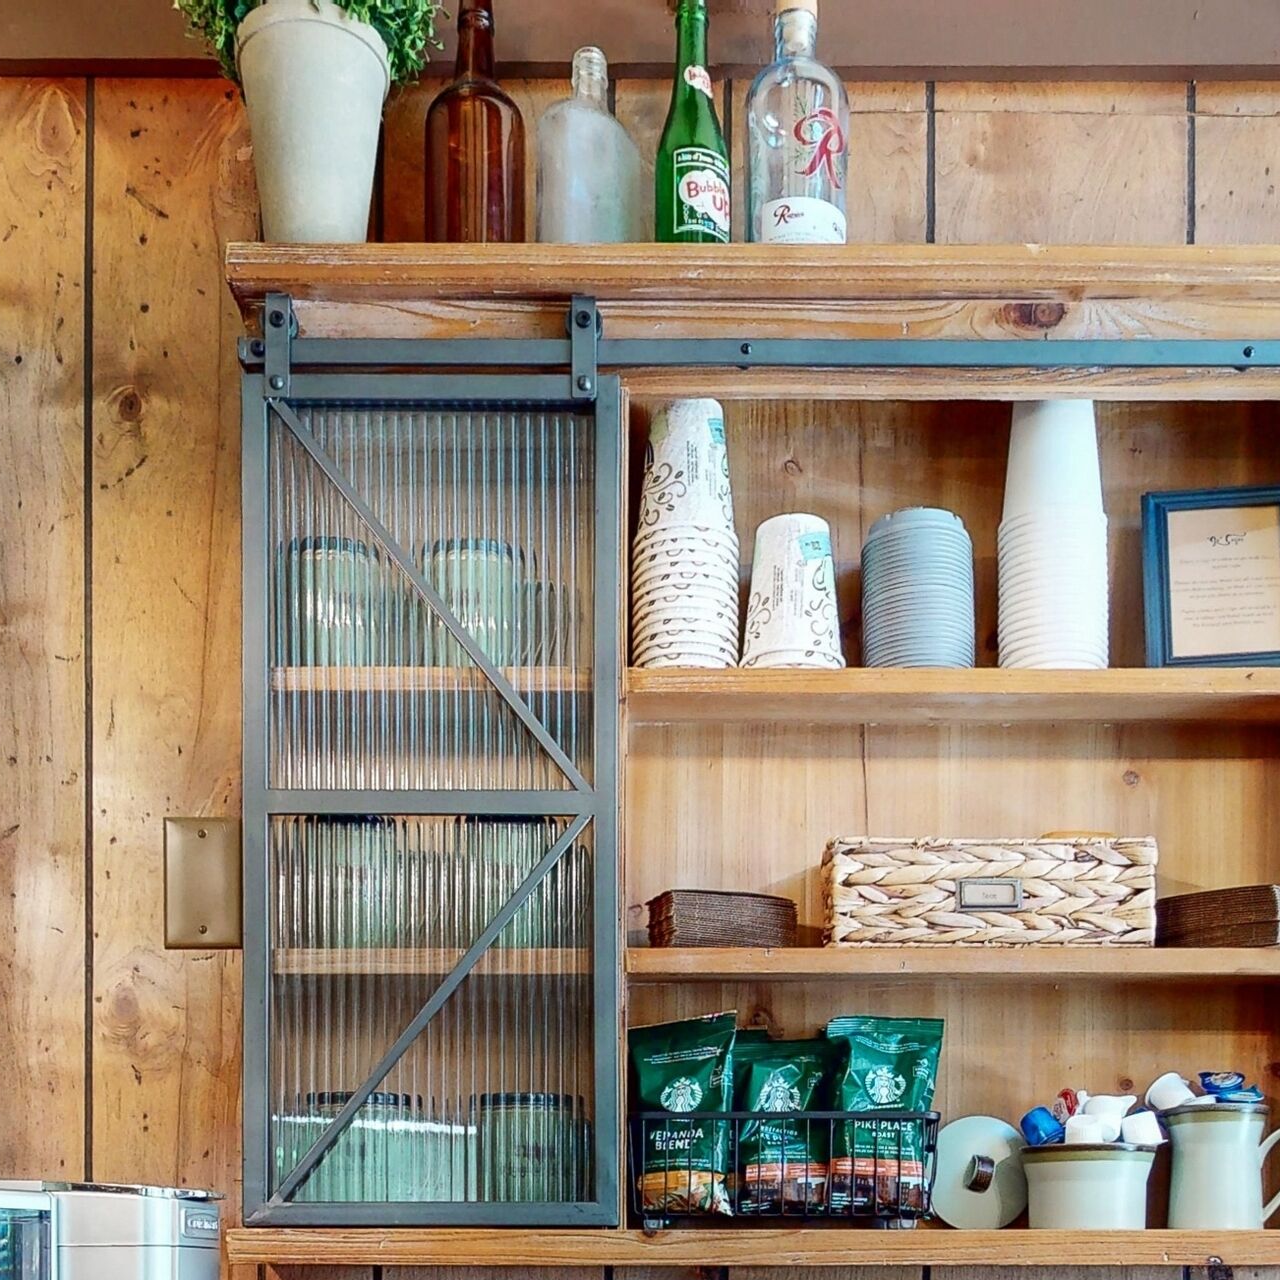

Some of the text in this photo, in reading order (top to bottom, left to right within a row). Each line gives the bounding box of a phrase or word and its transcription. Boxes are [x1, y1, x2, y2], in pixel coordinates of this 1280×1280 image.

[686, 181, 726, 199] Bubble
[855, 1121, 914, 1131] PIKE PLACE
